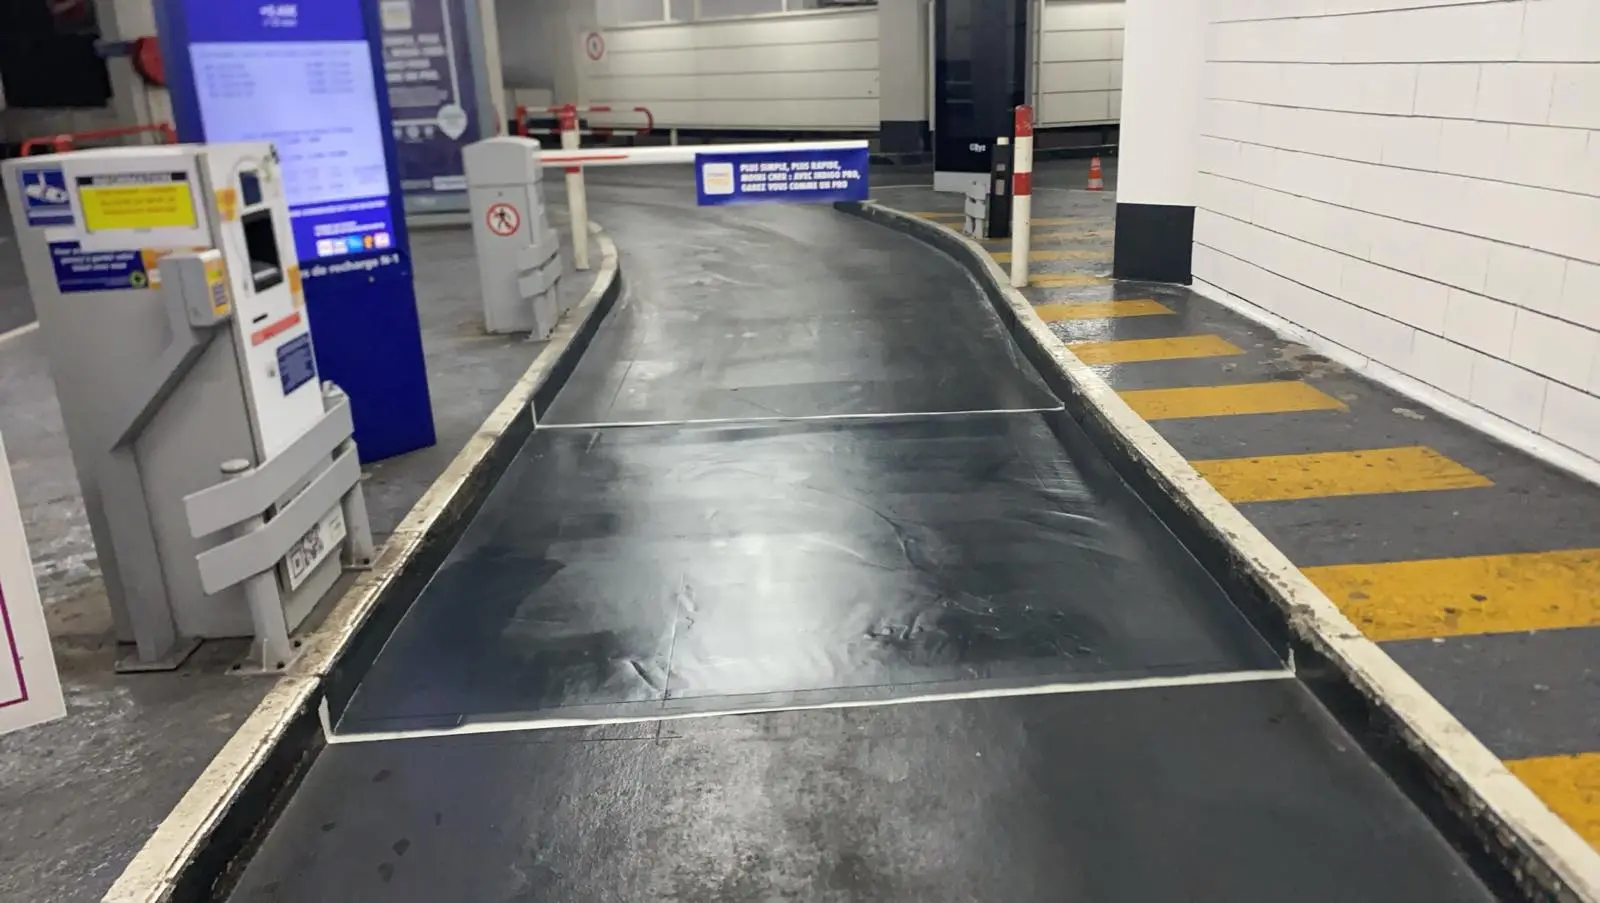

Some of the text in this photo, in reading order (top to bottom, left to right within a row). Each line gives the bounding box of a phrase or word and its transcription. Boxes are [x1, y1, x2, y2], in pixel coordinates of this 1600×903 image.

[740, 160, 841, 172] PLUS SIMPLE, PLUS RAPIDE,
[740, 173, 766, 182] MOINS
[767, 172, 787, 181] CHER
[793, 171, 812, 181] AVEC
[813, 170, 840, 180] INDIGO
[842, 169, 861, 180] PRO,
[741, 180, 848, 192] GAREZ VOUS COMME UN PRO
